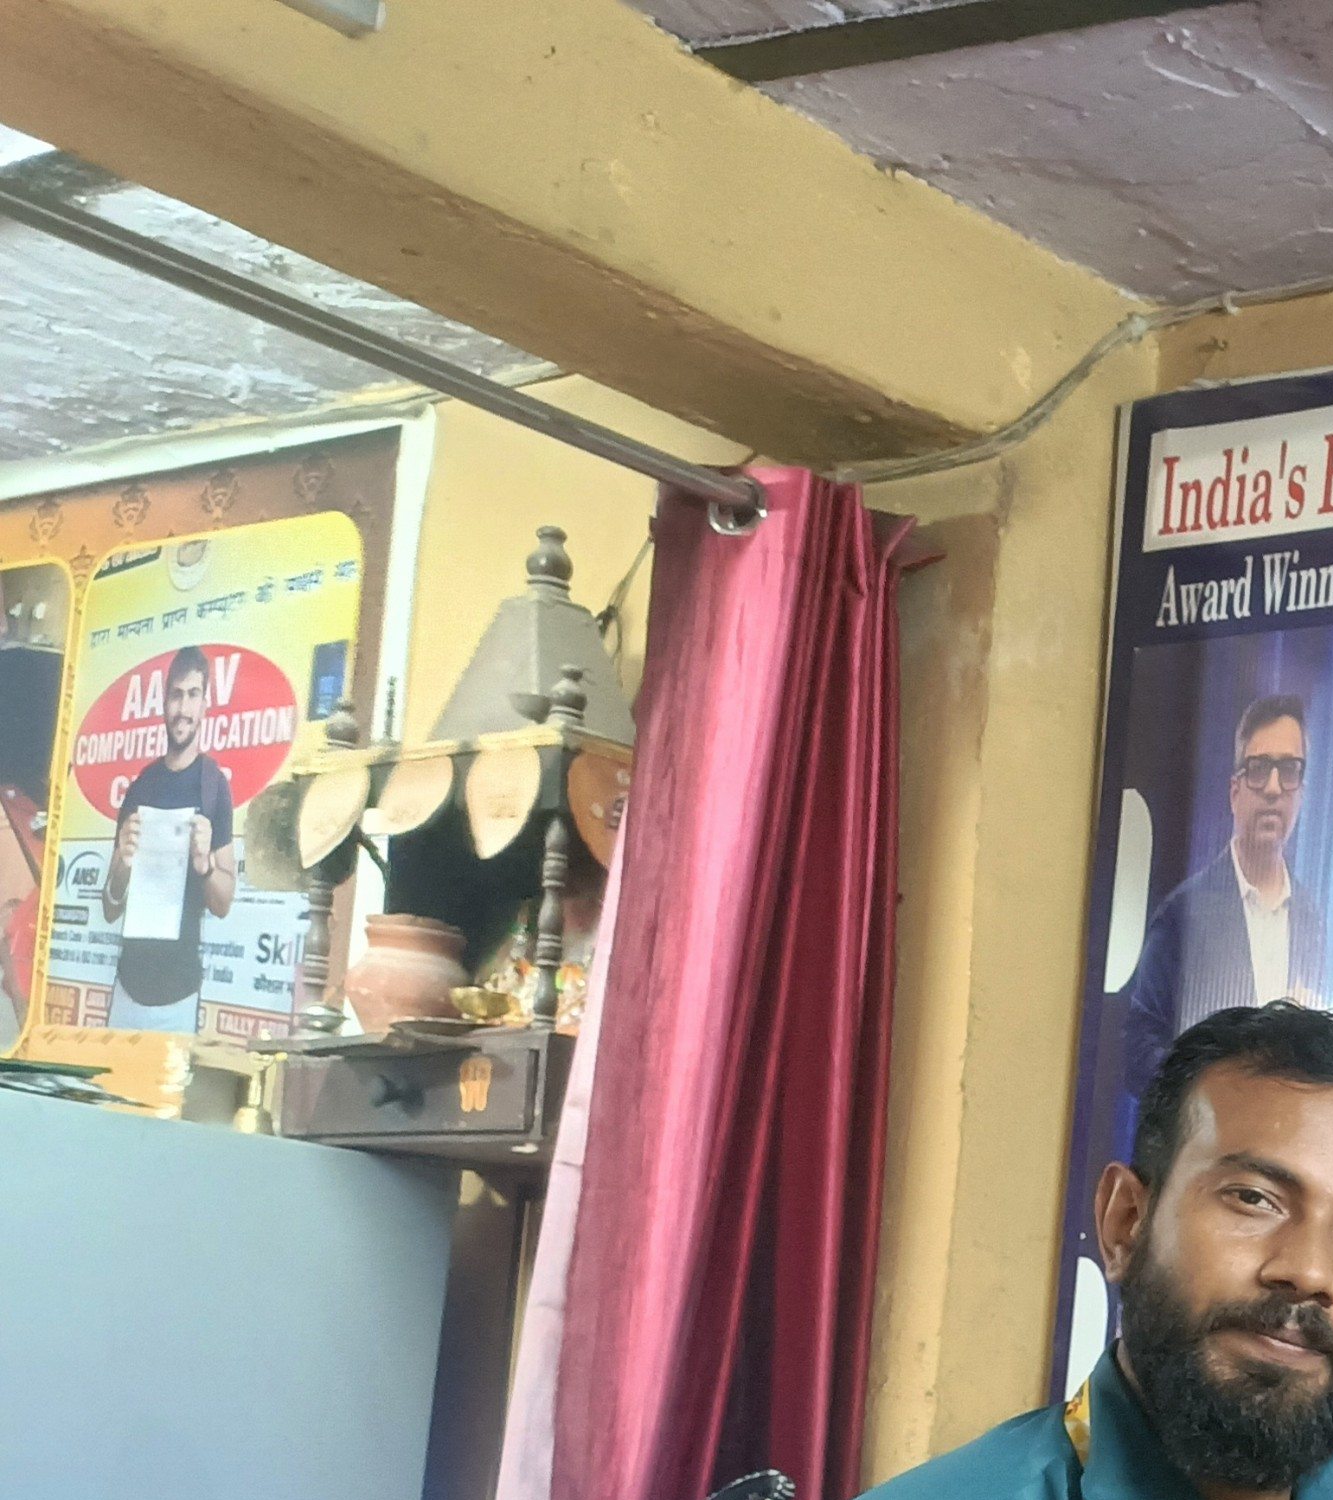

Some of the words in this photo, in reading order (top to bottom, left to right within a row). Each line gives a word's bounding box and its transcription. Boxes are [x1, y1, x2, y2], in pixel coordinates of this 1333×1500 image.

[1158, 440, 1307, 537] India's
[1155, 556, 1254, 628] Award
[121, 653, 241, 721] AAV
[199, 705, 294, 751] UCATION
